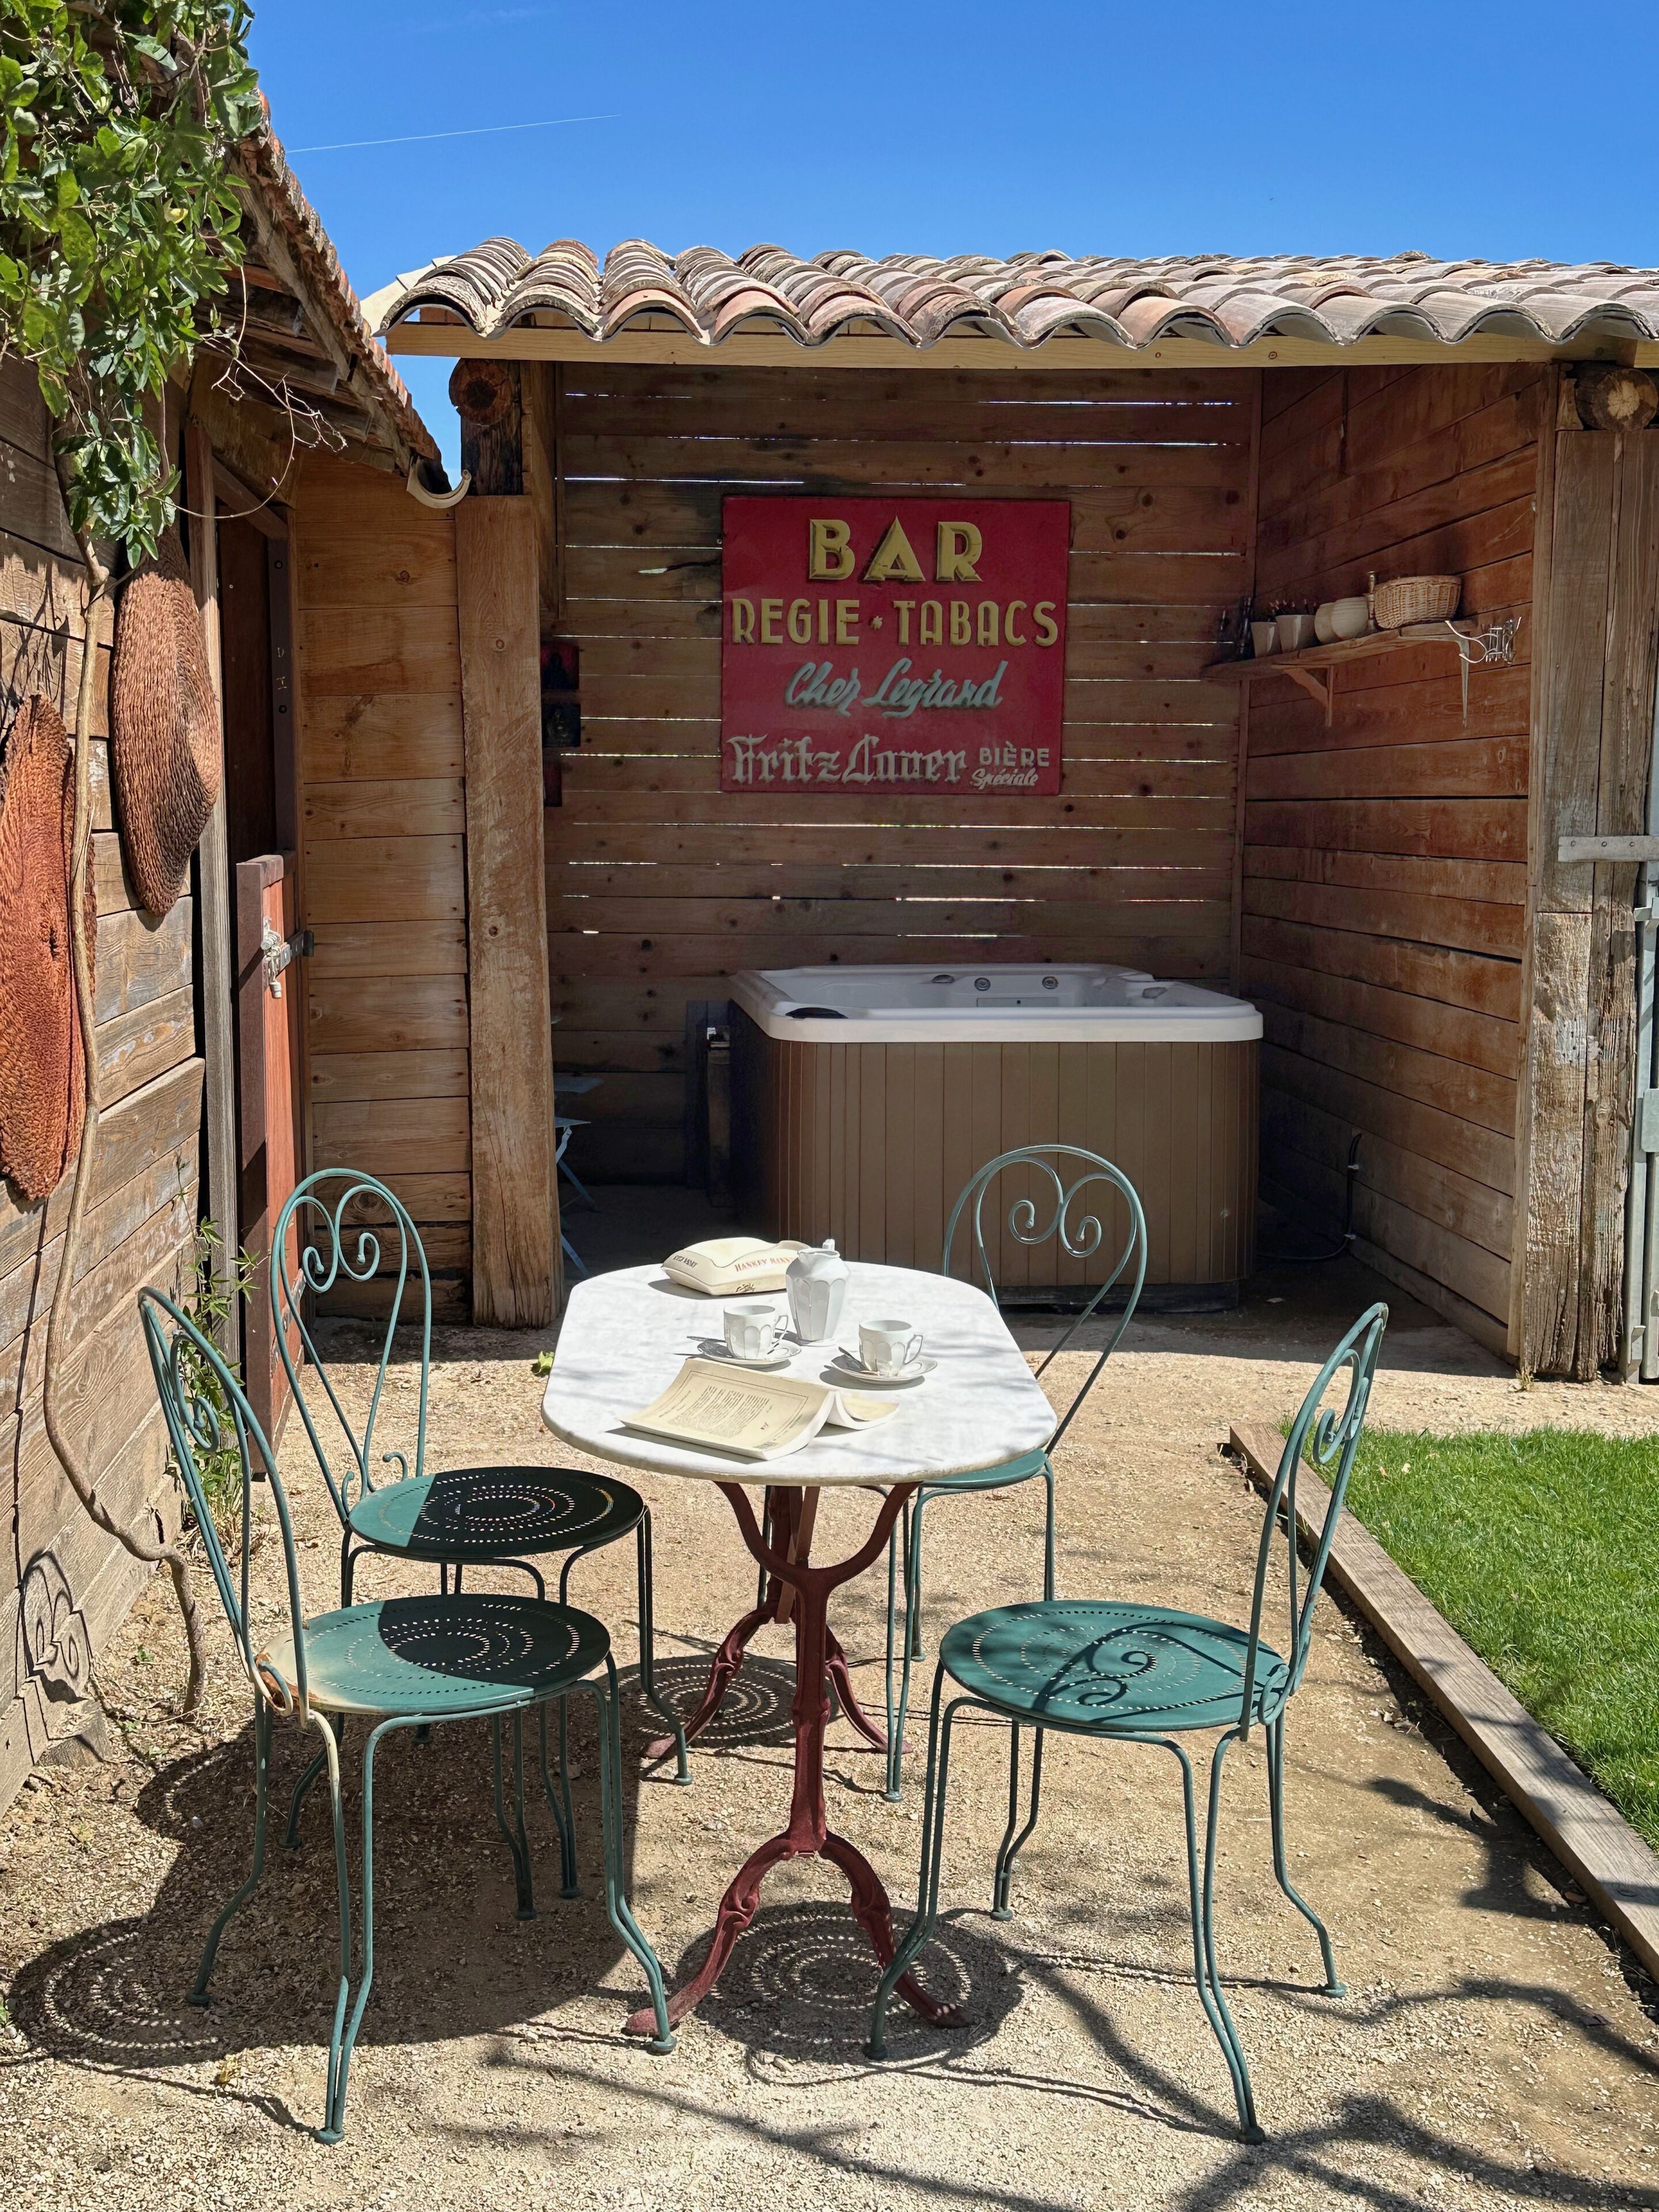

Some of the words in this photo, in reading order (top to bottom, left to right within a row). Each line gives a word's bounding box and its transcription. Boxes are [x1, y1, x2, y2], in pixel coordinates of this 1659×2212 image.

[809, 516, 983, 582] BAR
[732, 598, 860, 646] REGIE
[893, 600, 1059, 647] TABACS
[861, 657, 1009, 718] Legrand
[979, 741, 1050, 767] BIÈRE
[970, 768, 1039, 790] Spéciale
[734, 1259, 767, 1272] HANKEY
